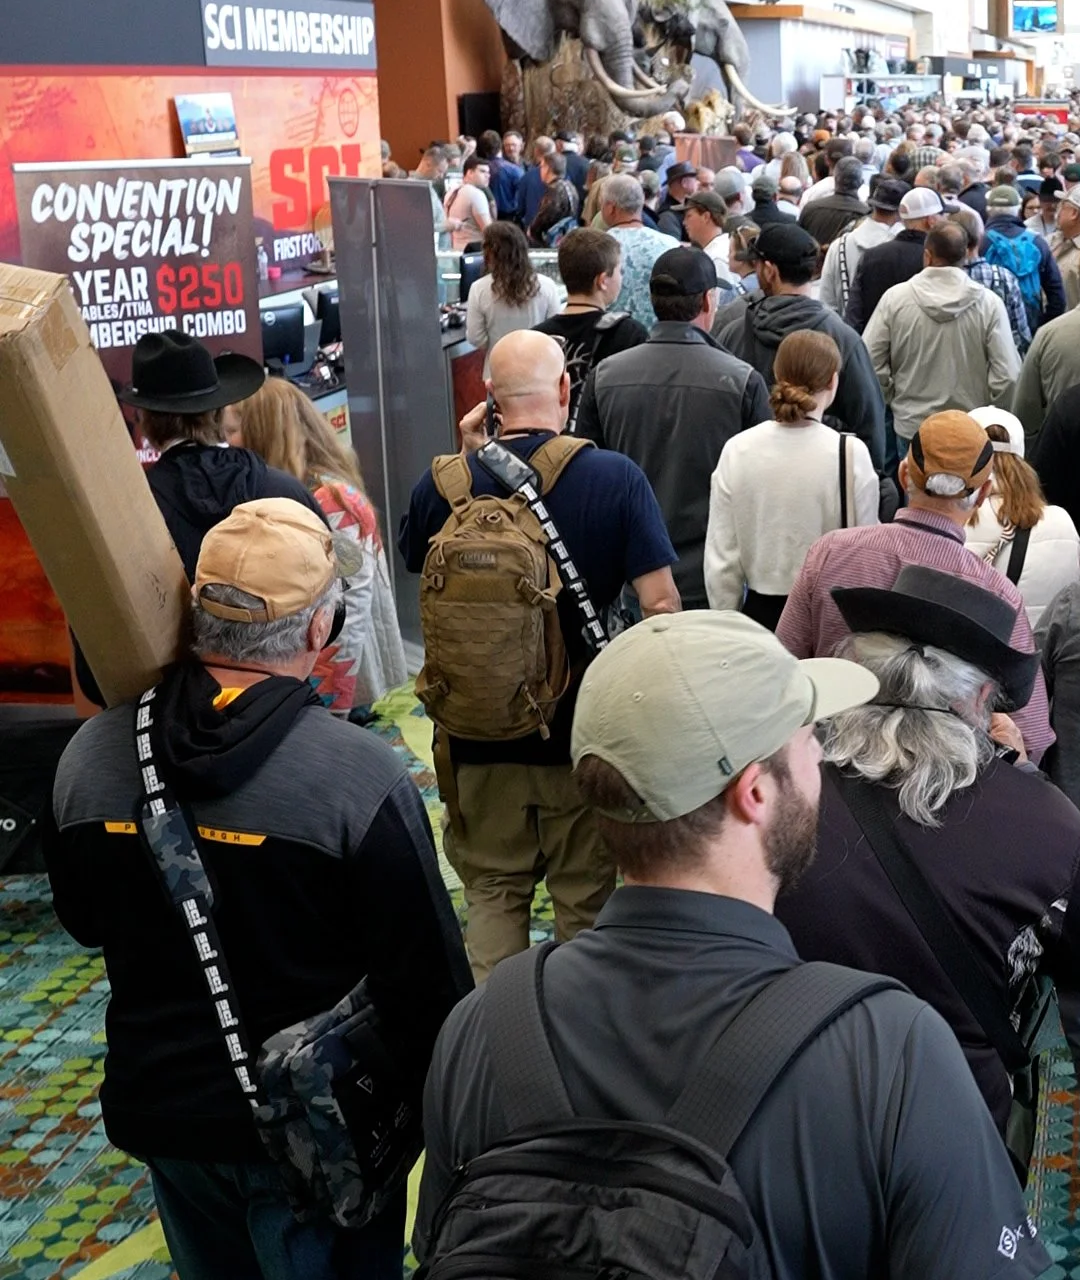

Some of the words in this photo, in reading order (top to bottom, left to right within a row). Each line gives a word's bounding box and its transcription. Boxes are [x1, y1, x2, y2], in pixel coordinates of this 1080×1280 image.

[204, 3, 242, 50] SCI
[245, 7, 375, 55] MEMBERSHIP
[31, 177, 242, 223] CONVENTION
[67, 210, 214, 262] SPECIAL!
[274, 235, 301, 261] FIRST
[70, 266, 148, 305] YEAR
[156, 263, 244, 314] $250
[79, 300, 153, 321] ABLES/TTHA
[182, 310, 246, 337] COMBO
